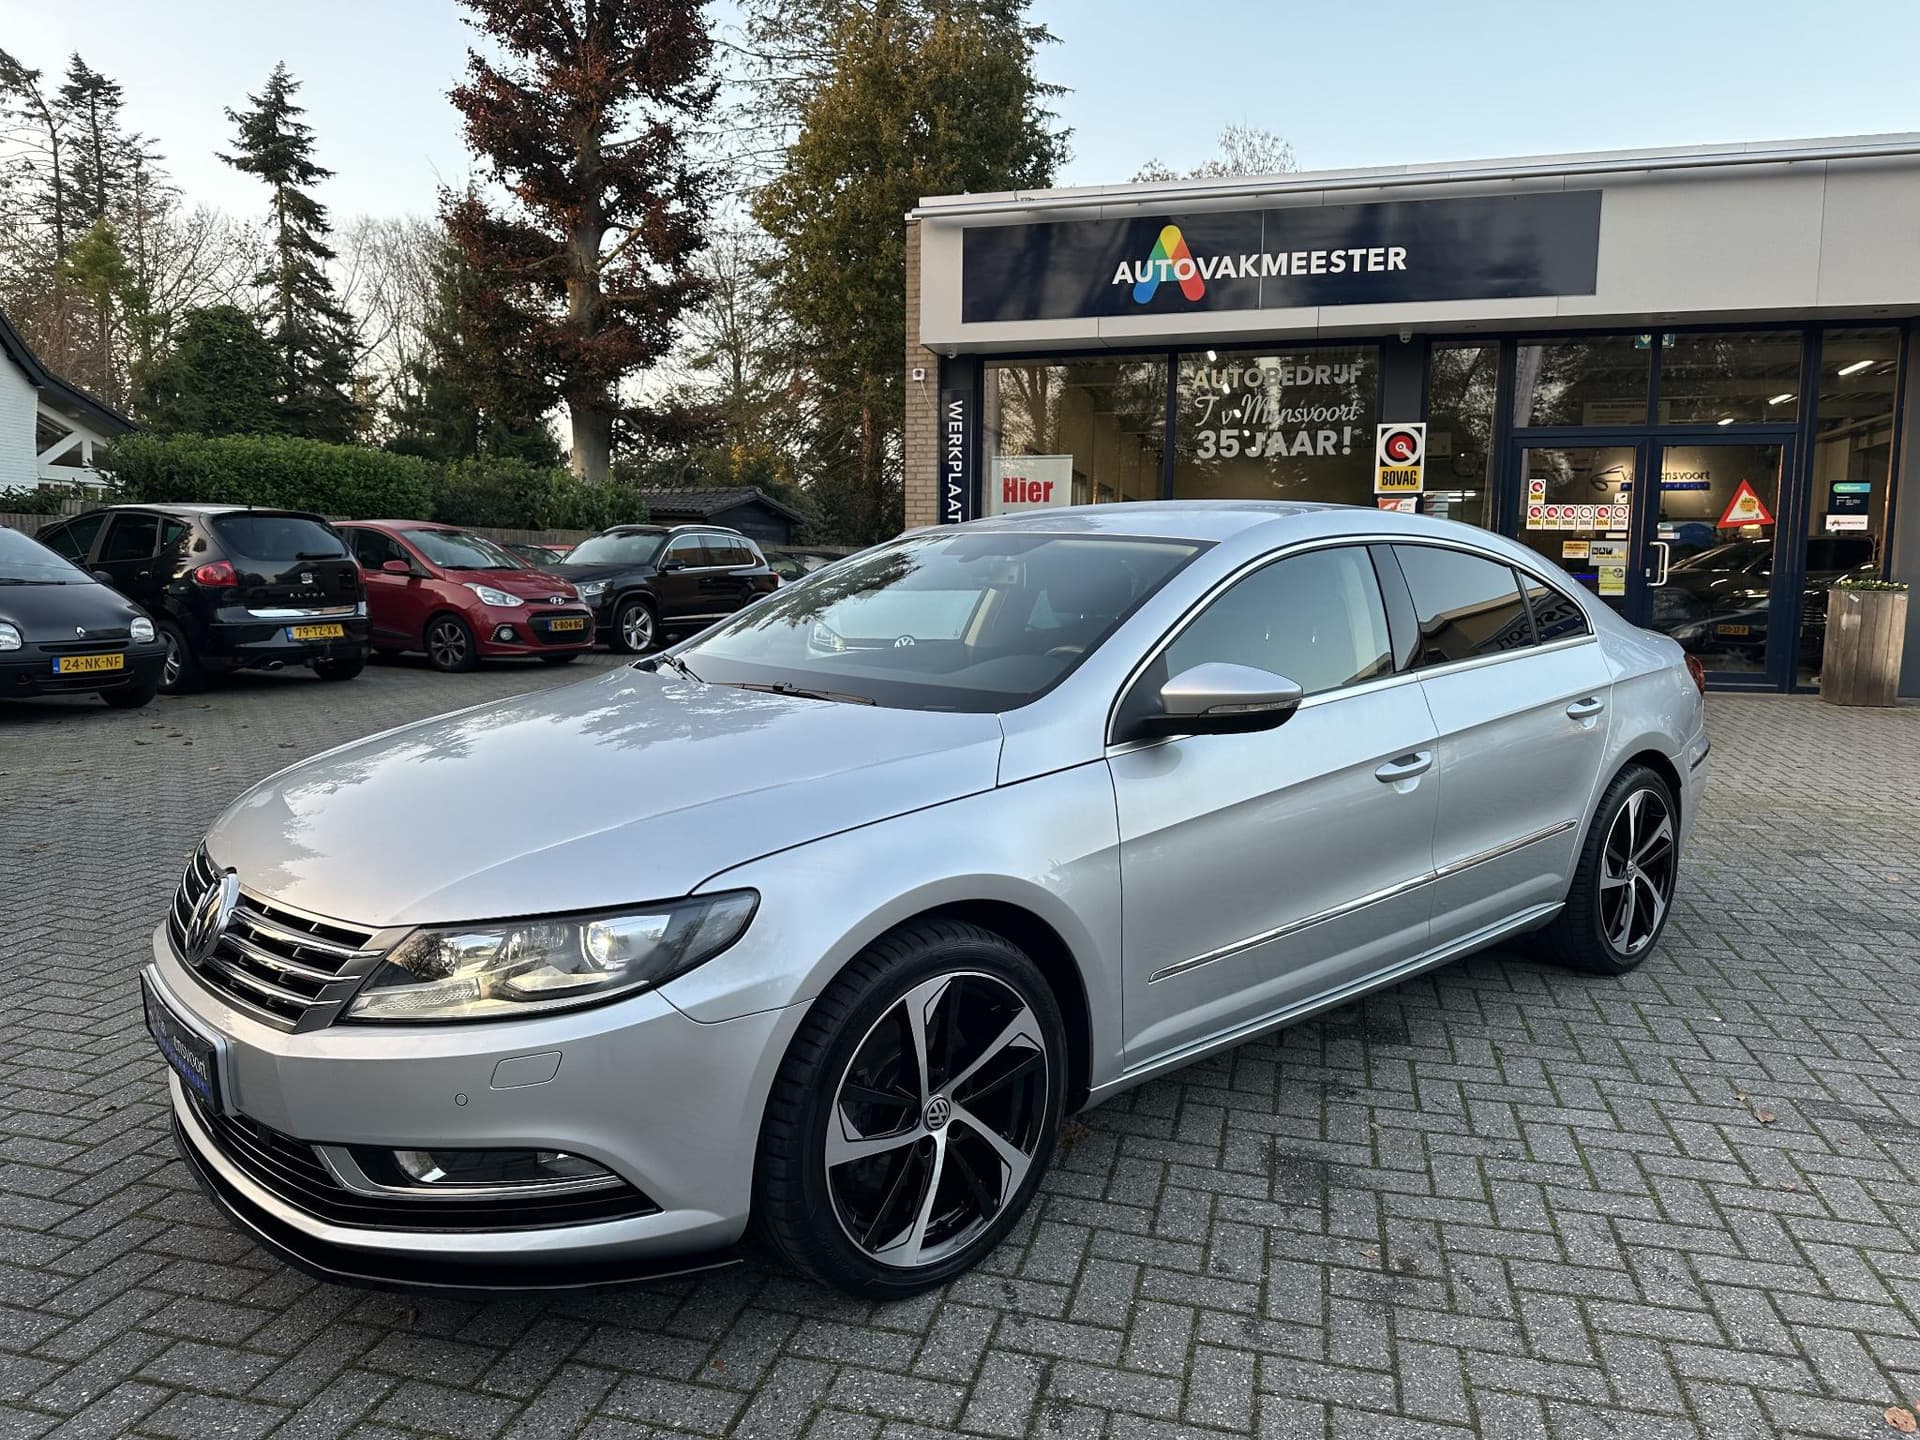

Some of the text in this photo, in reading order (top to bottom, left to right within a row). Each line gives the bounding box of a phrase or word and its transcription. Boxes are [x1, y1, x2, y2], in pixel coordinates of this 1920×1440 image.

[1112, 247, 1408, 285] AUTOVAKMEESTER
[1193, 364, 1362, 389] AUTOBEDRIJF
[1241, 393, 1359, 427] Mnsvoort
[1197, 426, 1352, 459] 35 JAAR!
[947, 399, 964, 523] WERKPLAAT
[1003, 477, 1054, 503] Hier
[1382, 470, 1417, 486] BOVAG
[296, 626, 339, 637] 79-TZ-XX
[63, 656, 121, 671] 24-NK-NF
